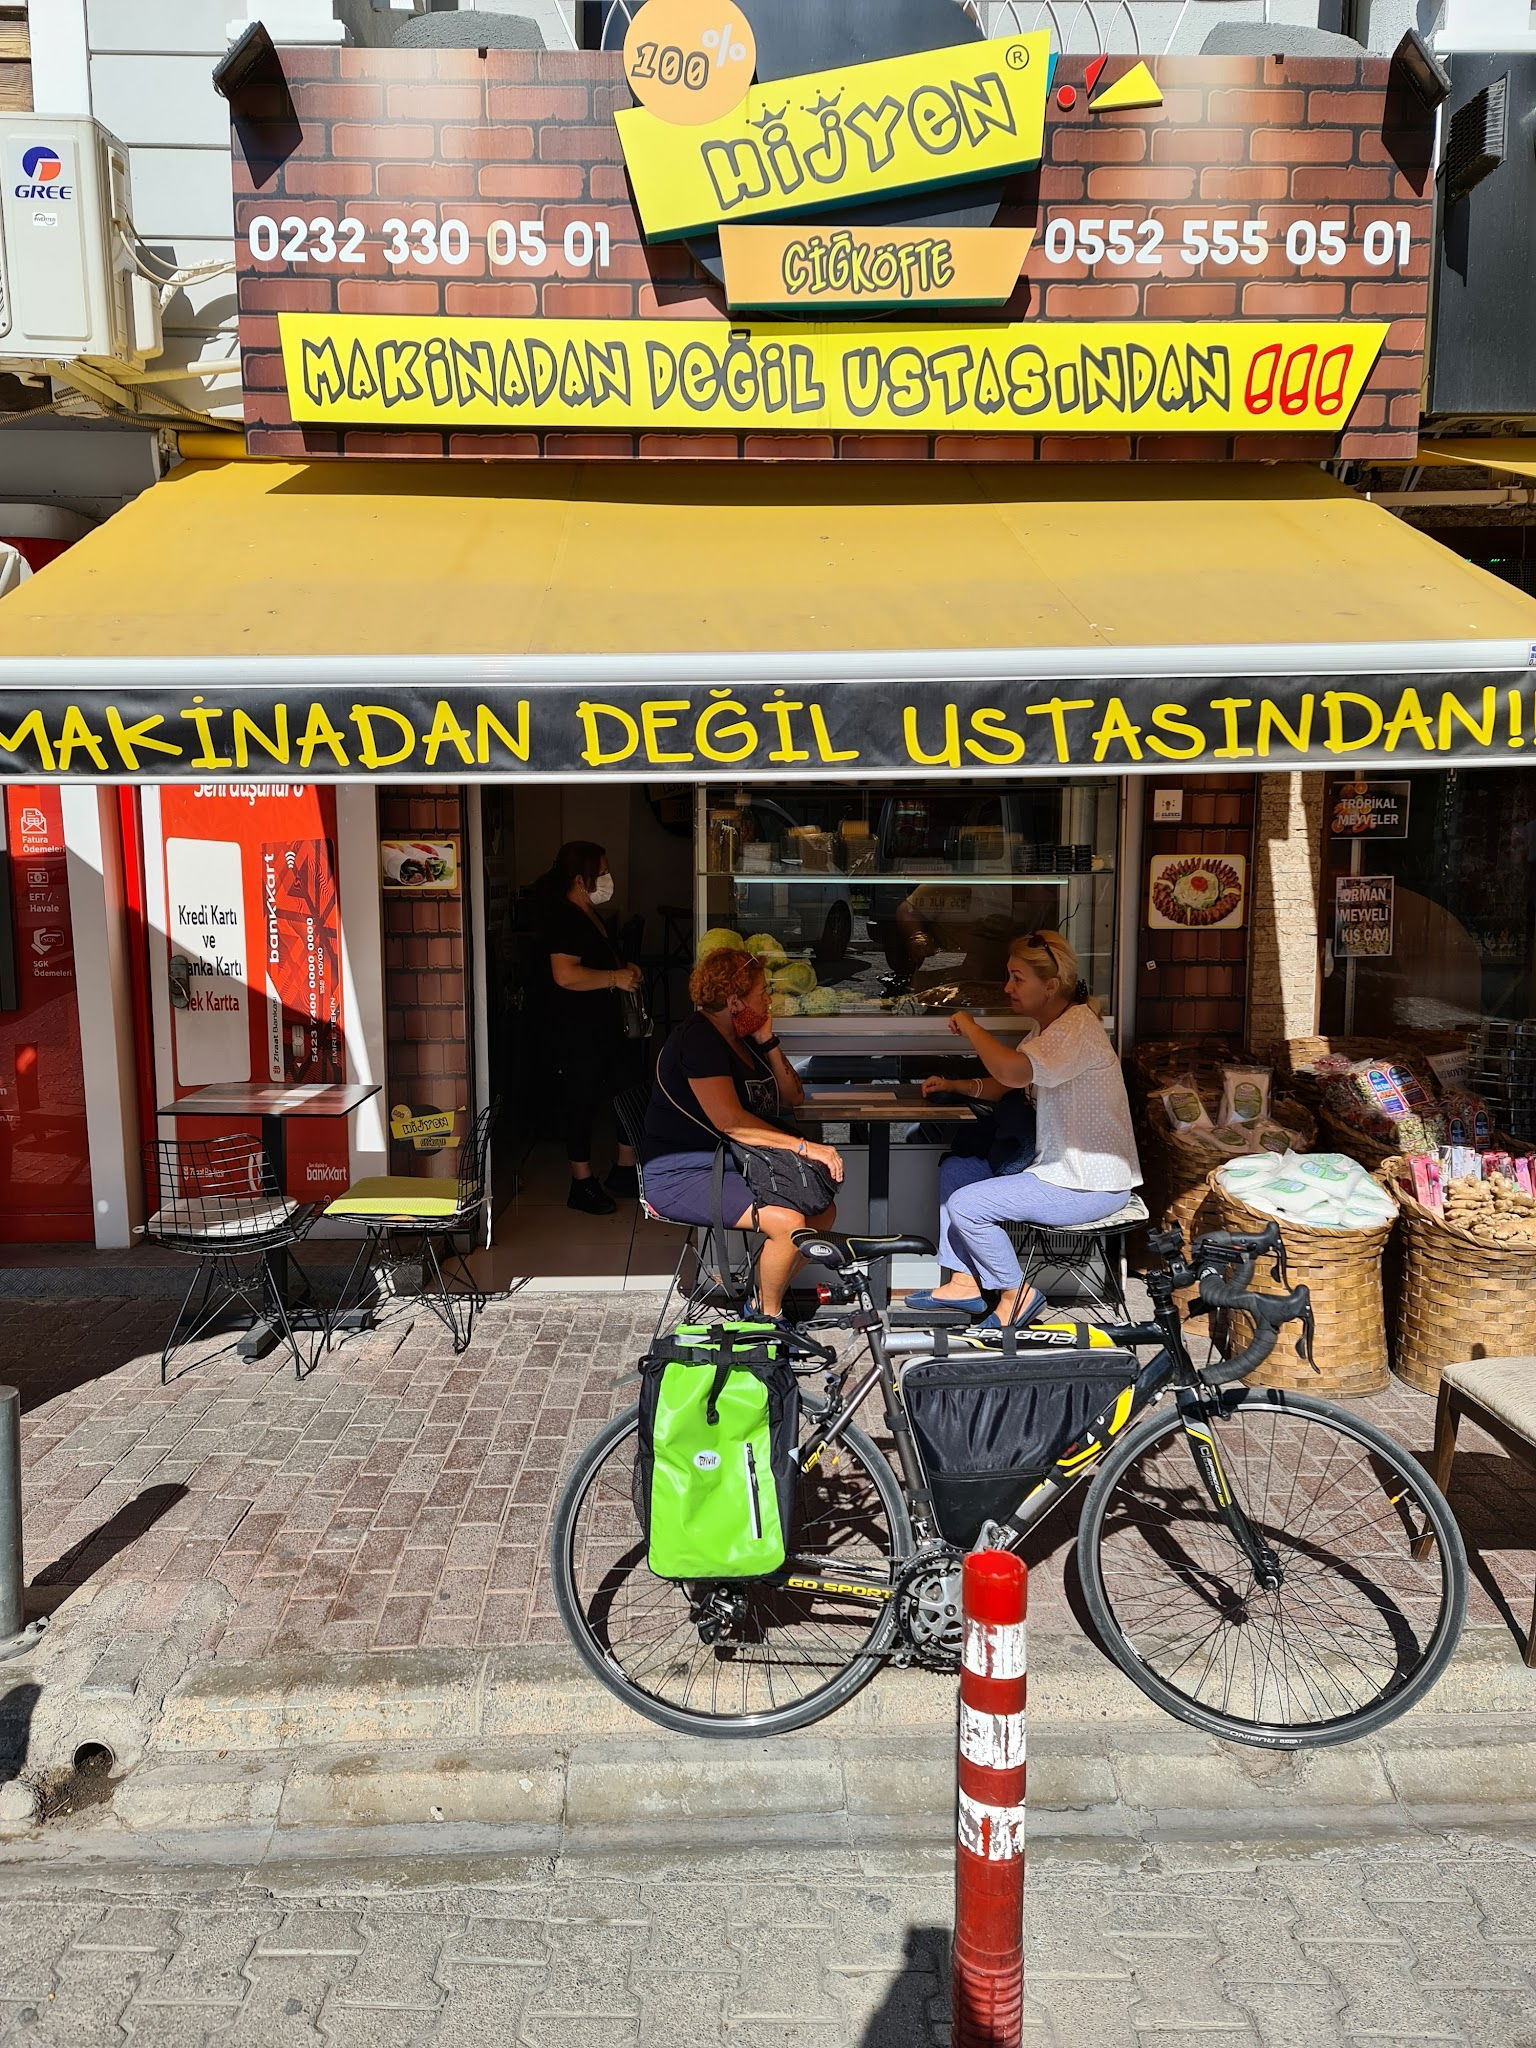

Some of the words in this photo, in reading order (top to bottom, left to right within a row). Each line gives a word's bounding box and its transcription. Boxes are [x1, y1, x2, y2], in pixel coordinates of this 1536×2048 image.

[15, 184, 73, 200] GREE
[248, 216, 366, 264] 0232
[382, 217, 470, 265] 330
[489, 218, 547, 267] 05
[563, 220, 611, 267] 01
[1044, 218, 1163, 266] 0552
[1179, 219, 1269, 266] 555
[1285, 219, 1347, 266] 05
[1362, 219, 1411, 266] 01
[0, 696, 530, 771] MAKİNADAN
[575, 687, 860, 766] DEĞİL
[1341, 796, 1397, 809] TROPİKAL
[1338, 814, 1399, 825] MEYVELER
[22, 835, 48, 844] Fatura
[23, 844, 66, 853] Ödemeleri
[29, 893, 46, 901] EFT
[1342, 888, 1386, 902] ORMAN
[30, 904, 59, 913] Havale
[178, 904, 208, 925] Kredi
[211, 905, 237, 925] Kartı
[264, 853, 280, 963] bankkart
[202, 935, 216, 949] ve
[33, 960, 49, 968] SGK
[187, 956, 213, 976] anka
[216, 956, 242, 976] Kartı
[34, 968, 73, 977] Ödemeleri
[308, 955, 316, 989] 0000
[206, 991, 240, 1011] Kartta
[309, 992, 317, 1026] 7400
[311, 1030, 319, 1063] 5423
[306, 1166, 347, 1181] bankkart
[787, 1578, 819, 1590] GO
[822, 1582, 894, 1599] SPORT
[1229, 1730, 1276, 1744] RUBINO
